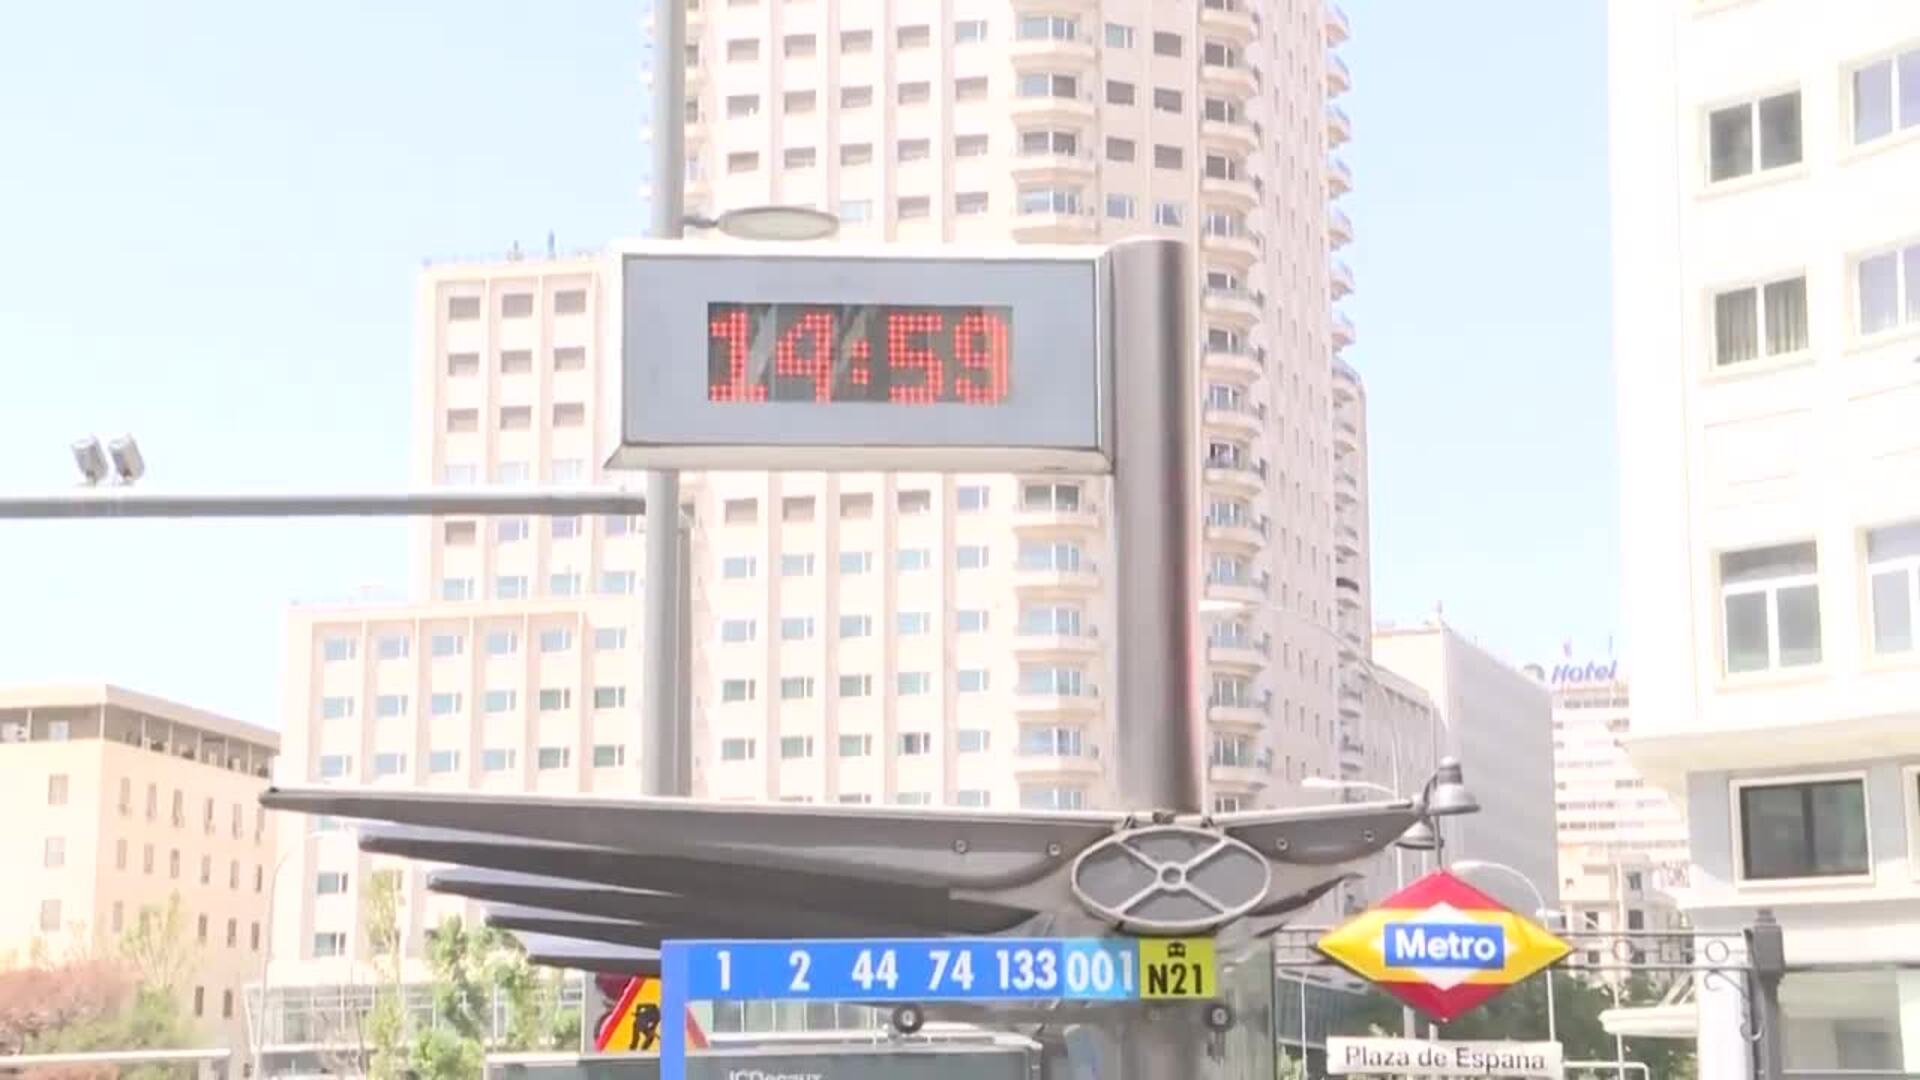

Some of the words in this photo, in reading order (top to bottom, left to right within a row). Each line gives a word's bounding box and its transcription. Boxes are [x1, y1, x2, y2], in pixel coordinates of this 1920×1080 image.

[710, 310, 1009, 405] 14:59
[1551, 659, 1618, 684] Hotel
[1395, 928, 1497, 960] Metro
[717, 951, 732, 990] 1
[789, 951, 811, 990] 2
[851, 951, 898, 990] 44
[928, 951, 975, 990] 74
[997, 950, 1057, 991] 133
[1066, 950, 1134, 991] 001
[1148, 963, 1203, 995] N21
[1345, 1045, 1410, 1067] Plaza
[1418, 1047, 1448, 1067] de
